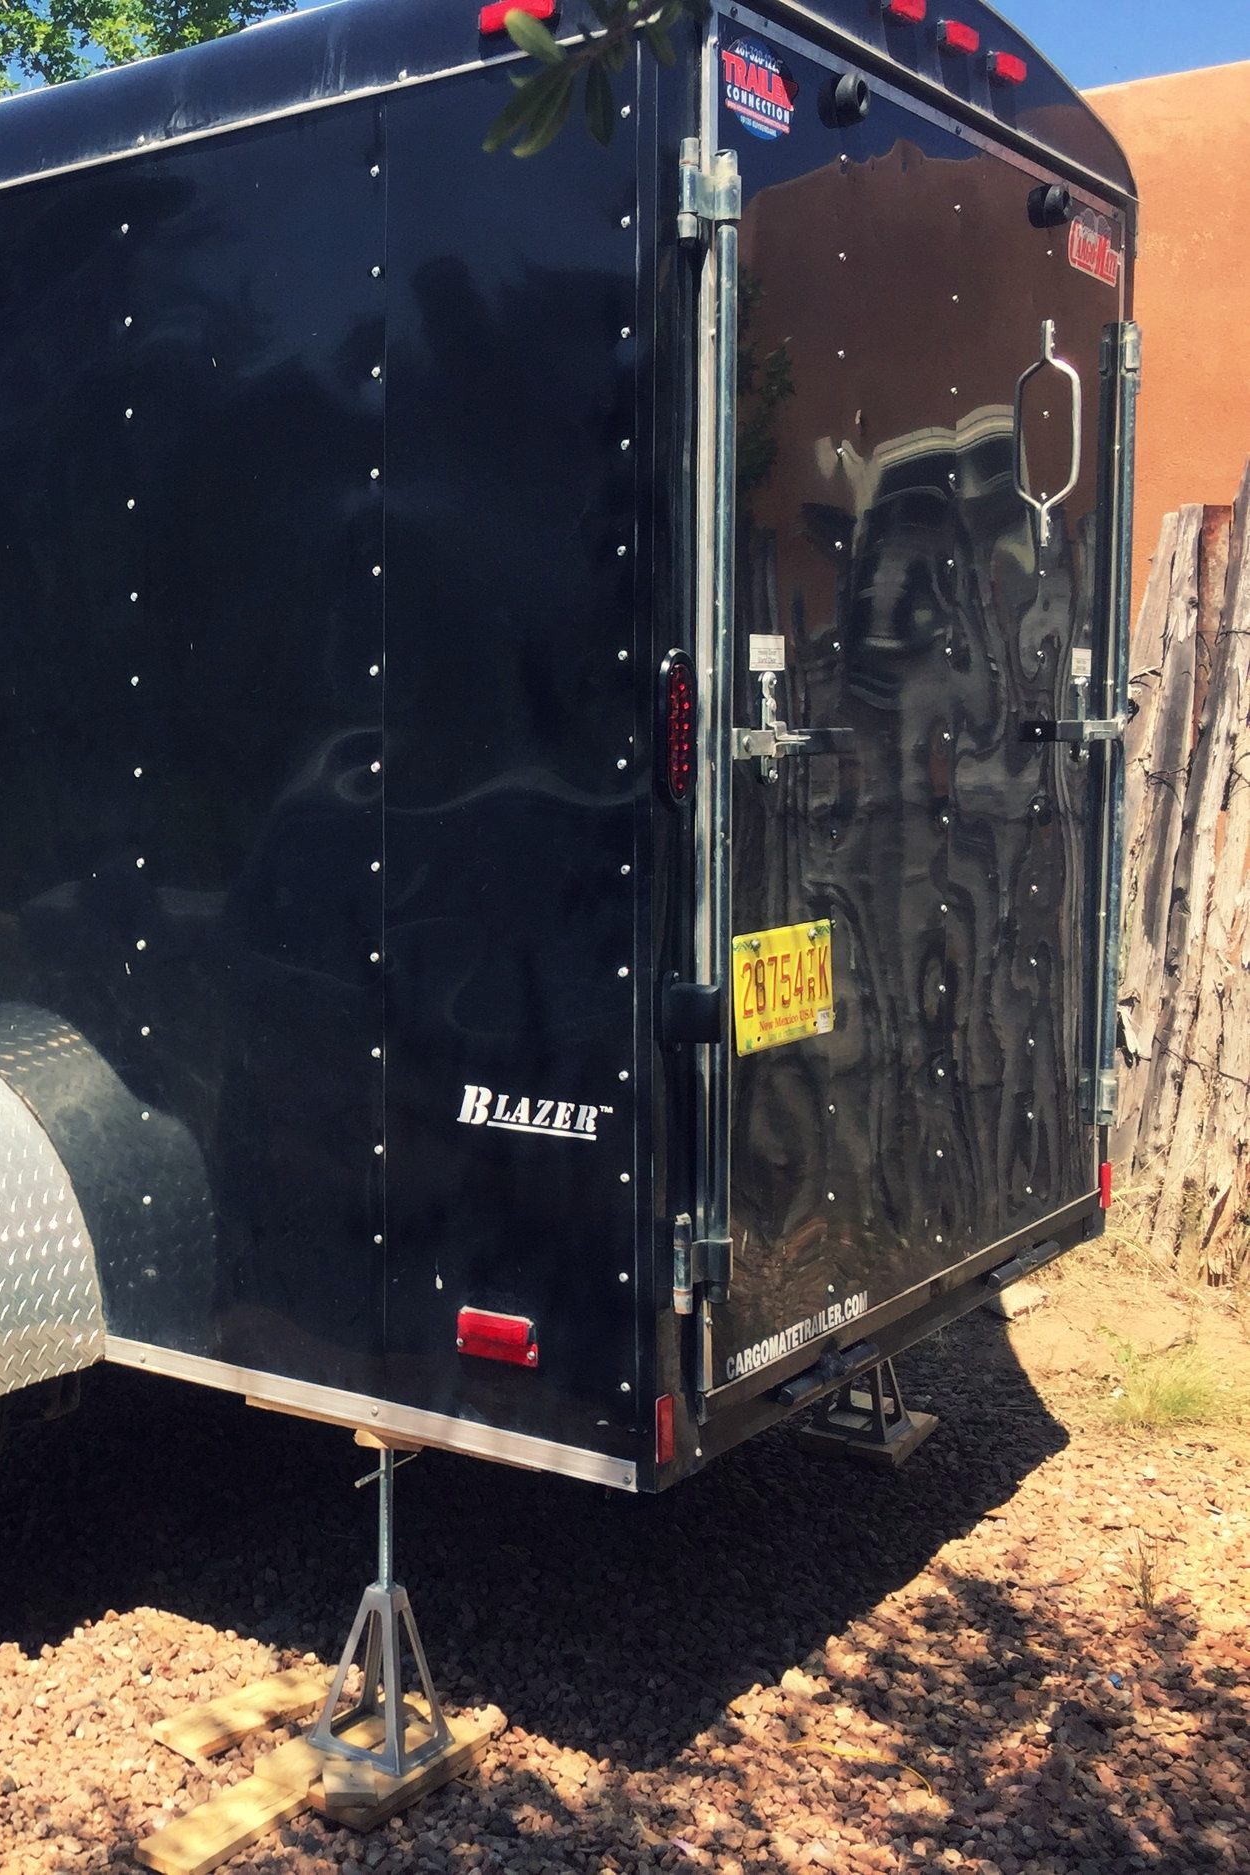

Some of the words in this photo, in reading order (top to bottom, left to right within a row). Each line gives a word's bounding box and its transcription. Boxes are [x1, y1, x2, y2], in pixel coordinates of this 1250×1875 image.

[722, 50, 798, 111] TRAILER
[727, 85, 790, 124] CONNECTION
[759, 1020, 774, 1032] New
[775, 1015, 799, 1027] Mexico
[799, 1008, 814, 1021] USA
[456, 1084, 598, 1133] BLAZER
[726, 1290, 868, 1380] CARGOMATETRAILER.COM
